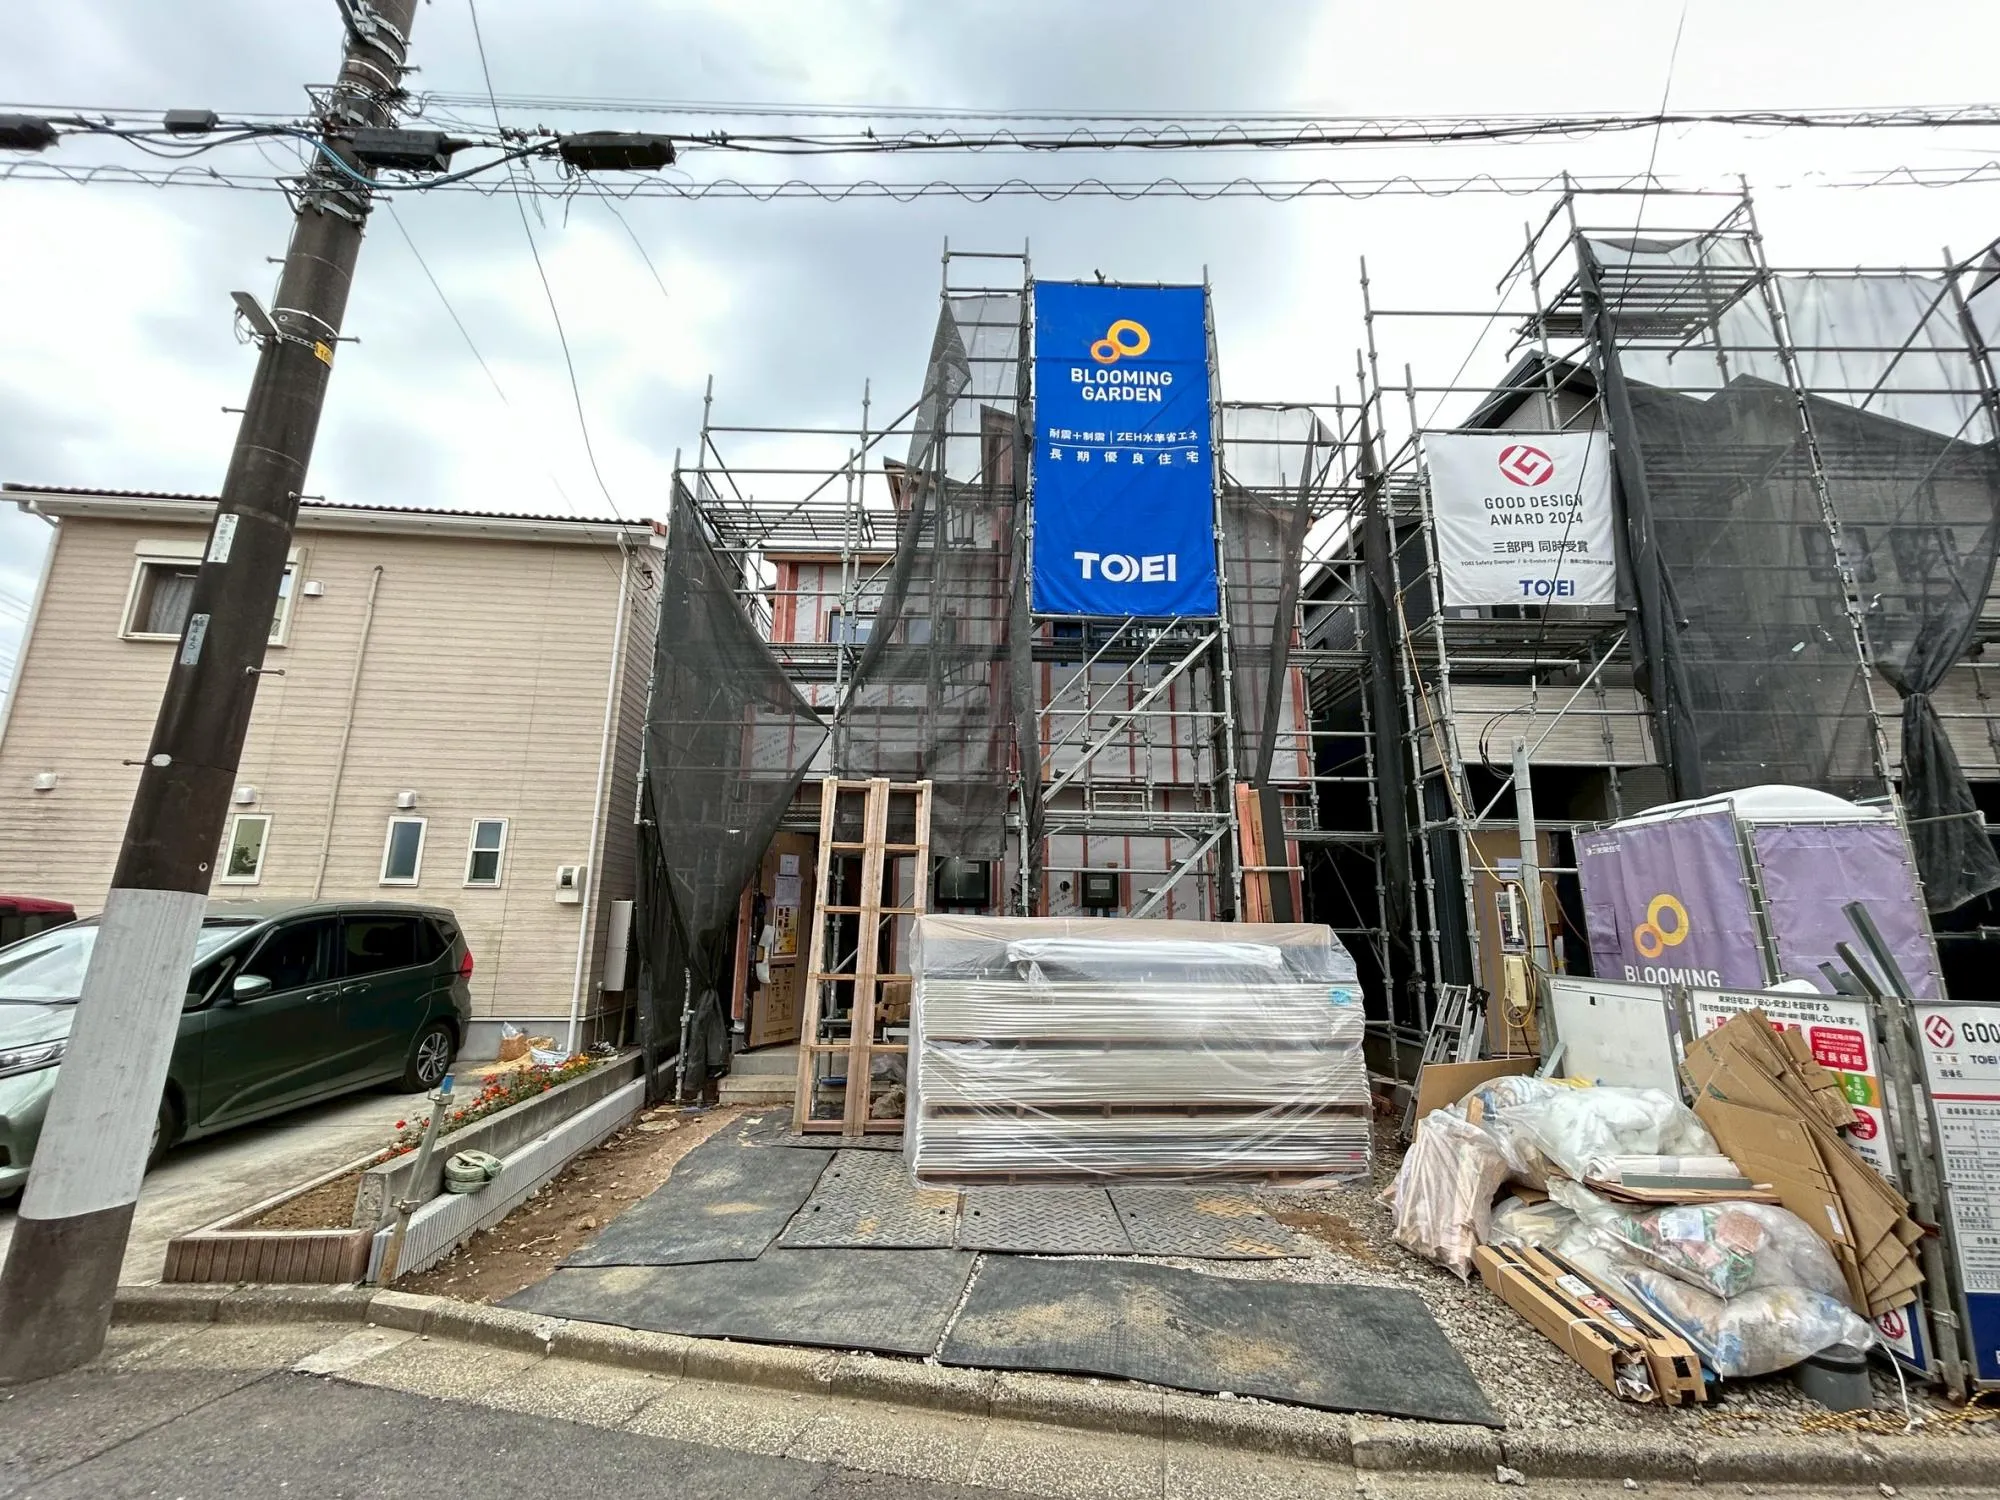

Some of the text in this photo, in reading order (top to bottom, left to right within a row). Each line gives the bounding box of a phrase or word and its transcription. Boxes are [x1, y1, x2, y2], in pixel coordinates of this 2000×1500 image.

[1070, 367, 1173, 386] BLOOMING
[1081, 386, 1162, 403] GARDEN
[1484, 494, 1583, 510] GOOD DESIGN
[1490, 511, 1583, 526] AWARD 2024
[1493, 540, 1589, 554] 三部門 同時受賞
[1073, 551, 1177, 583] TOEI
[1519, 579, 1575, 597] TOEI
[1624, 965, 1720, 988] BLOOMING
